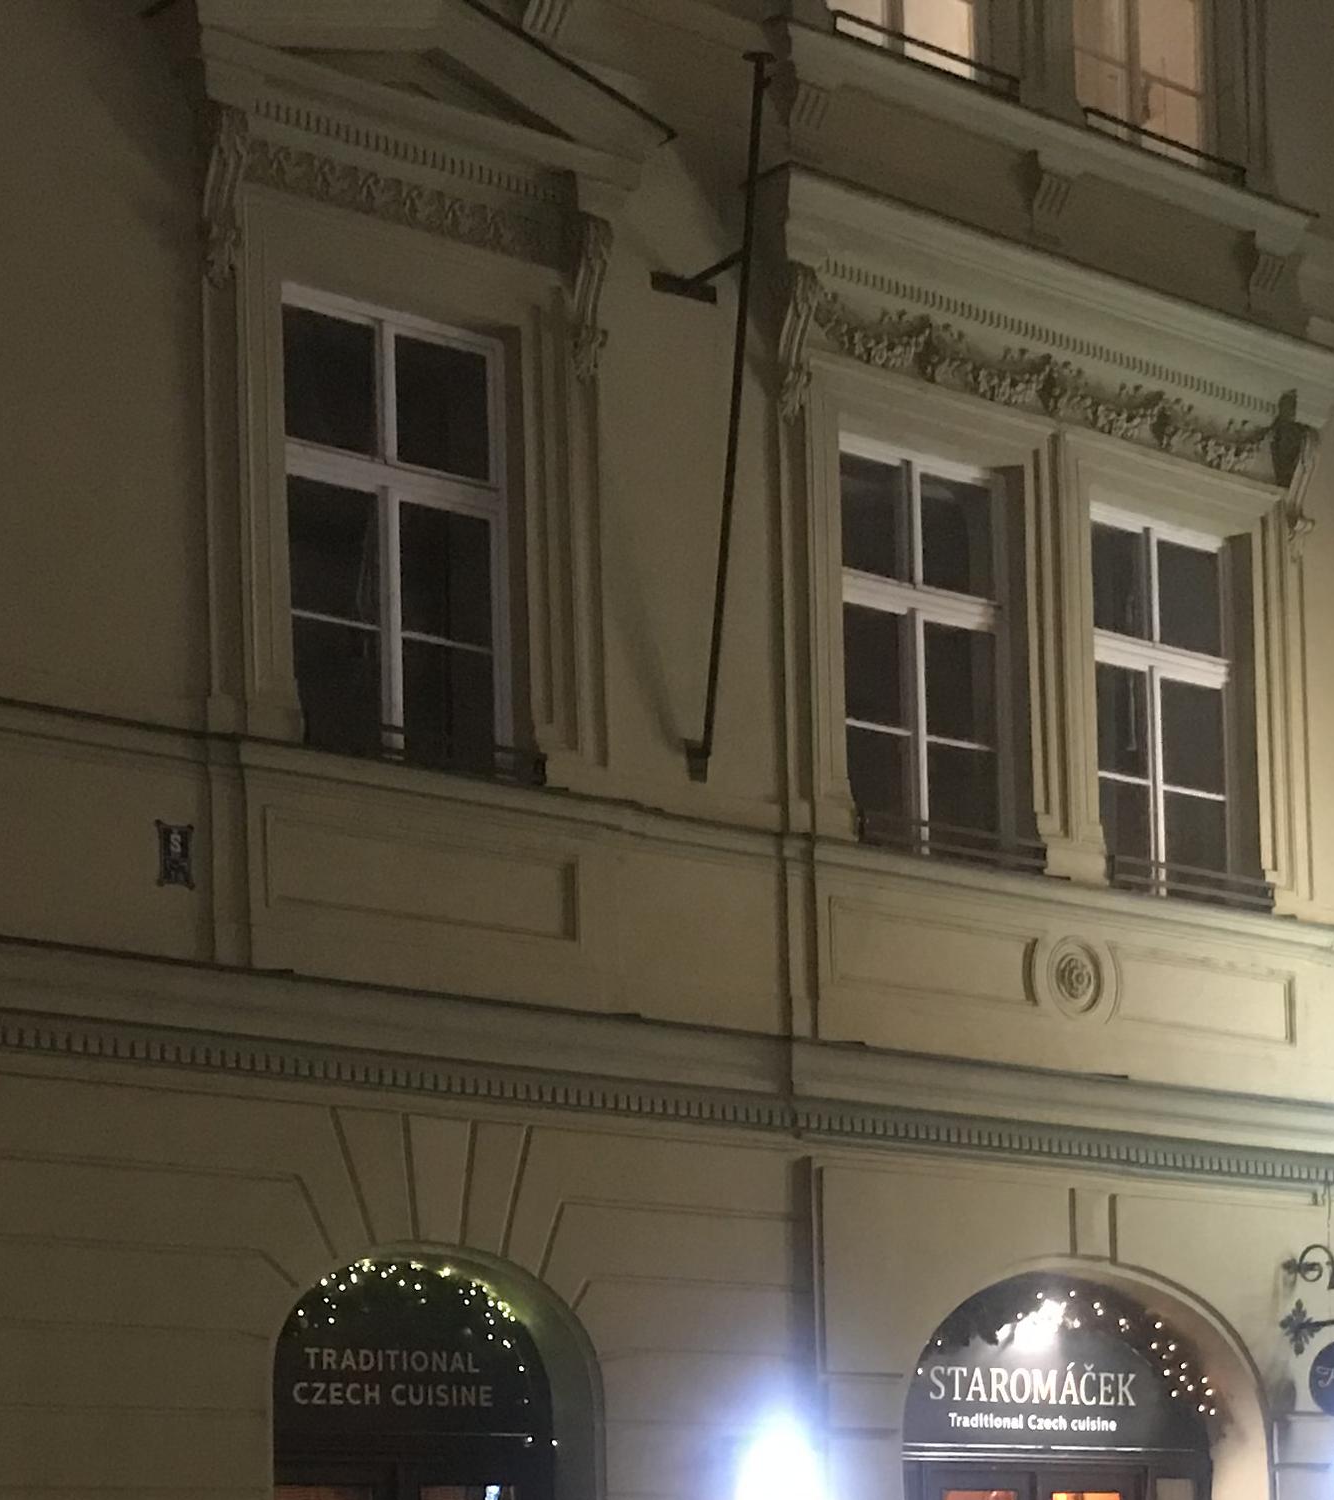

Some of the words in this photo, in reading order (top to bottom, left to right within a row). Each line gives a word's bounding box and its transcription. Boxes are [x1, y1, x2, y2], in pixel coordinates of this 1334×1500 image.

[304, 1347, 480, 1373] TRADITIONAL
[292, 1382, 380, 1406] CZECH
[391, 1384, 493, 1407] CUISINE
[929, 1362, 1136, 1406] STAROMÁČEK
[948, 1412, 1024, 1430] Traditional
[1027, 1414, 1067, 1431] Czech
[1070, 1416, 1117, 1432] cuisine
